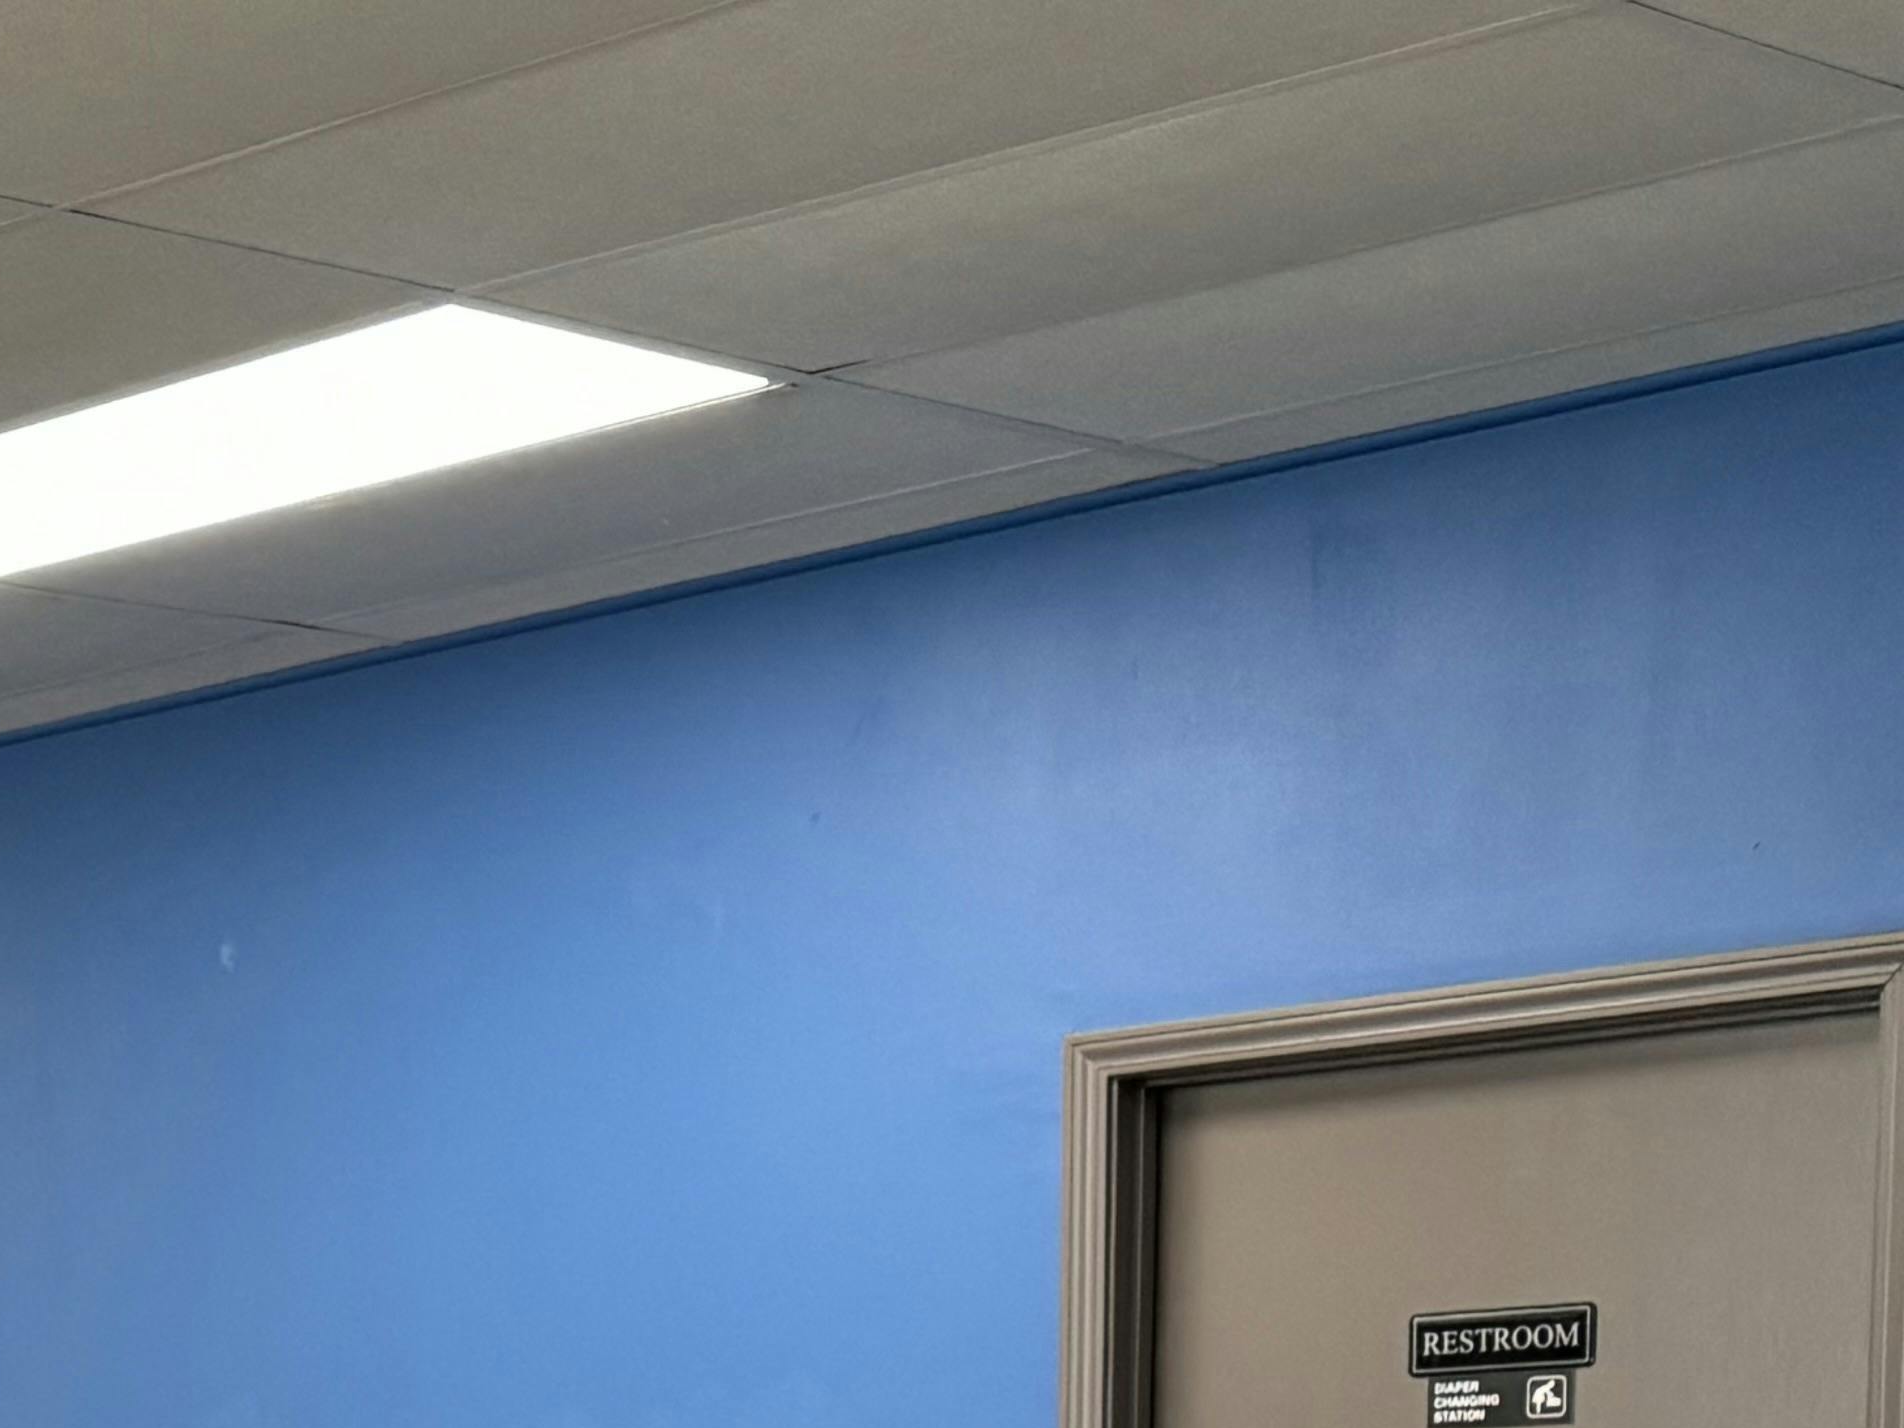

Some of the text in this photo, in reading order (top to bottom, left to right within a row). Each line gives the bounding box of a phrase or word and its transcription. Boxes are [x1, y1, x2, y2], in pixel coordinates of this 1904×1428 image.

[1423, 1322, 1580, 1356] RESTROOM
[1434, 1381, 1479, 1395] DIAPER
[1434, 1394, 1500, 1409] CHANGING
[1434, 1409, 1486, 1424] STATION
